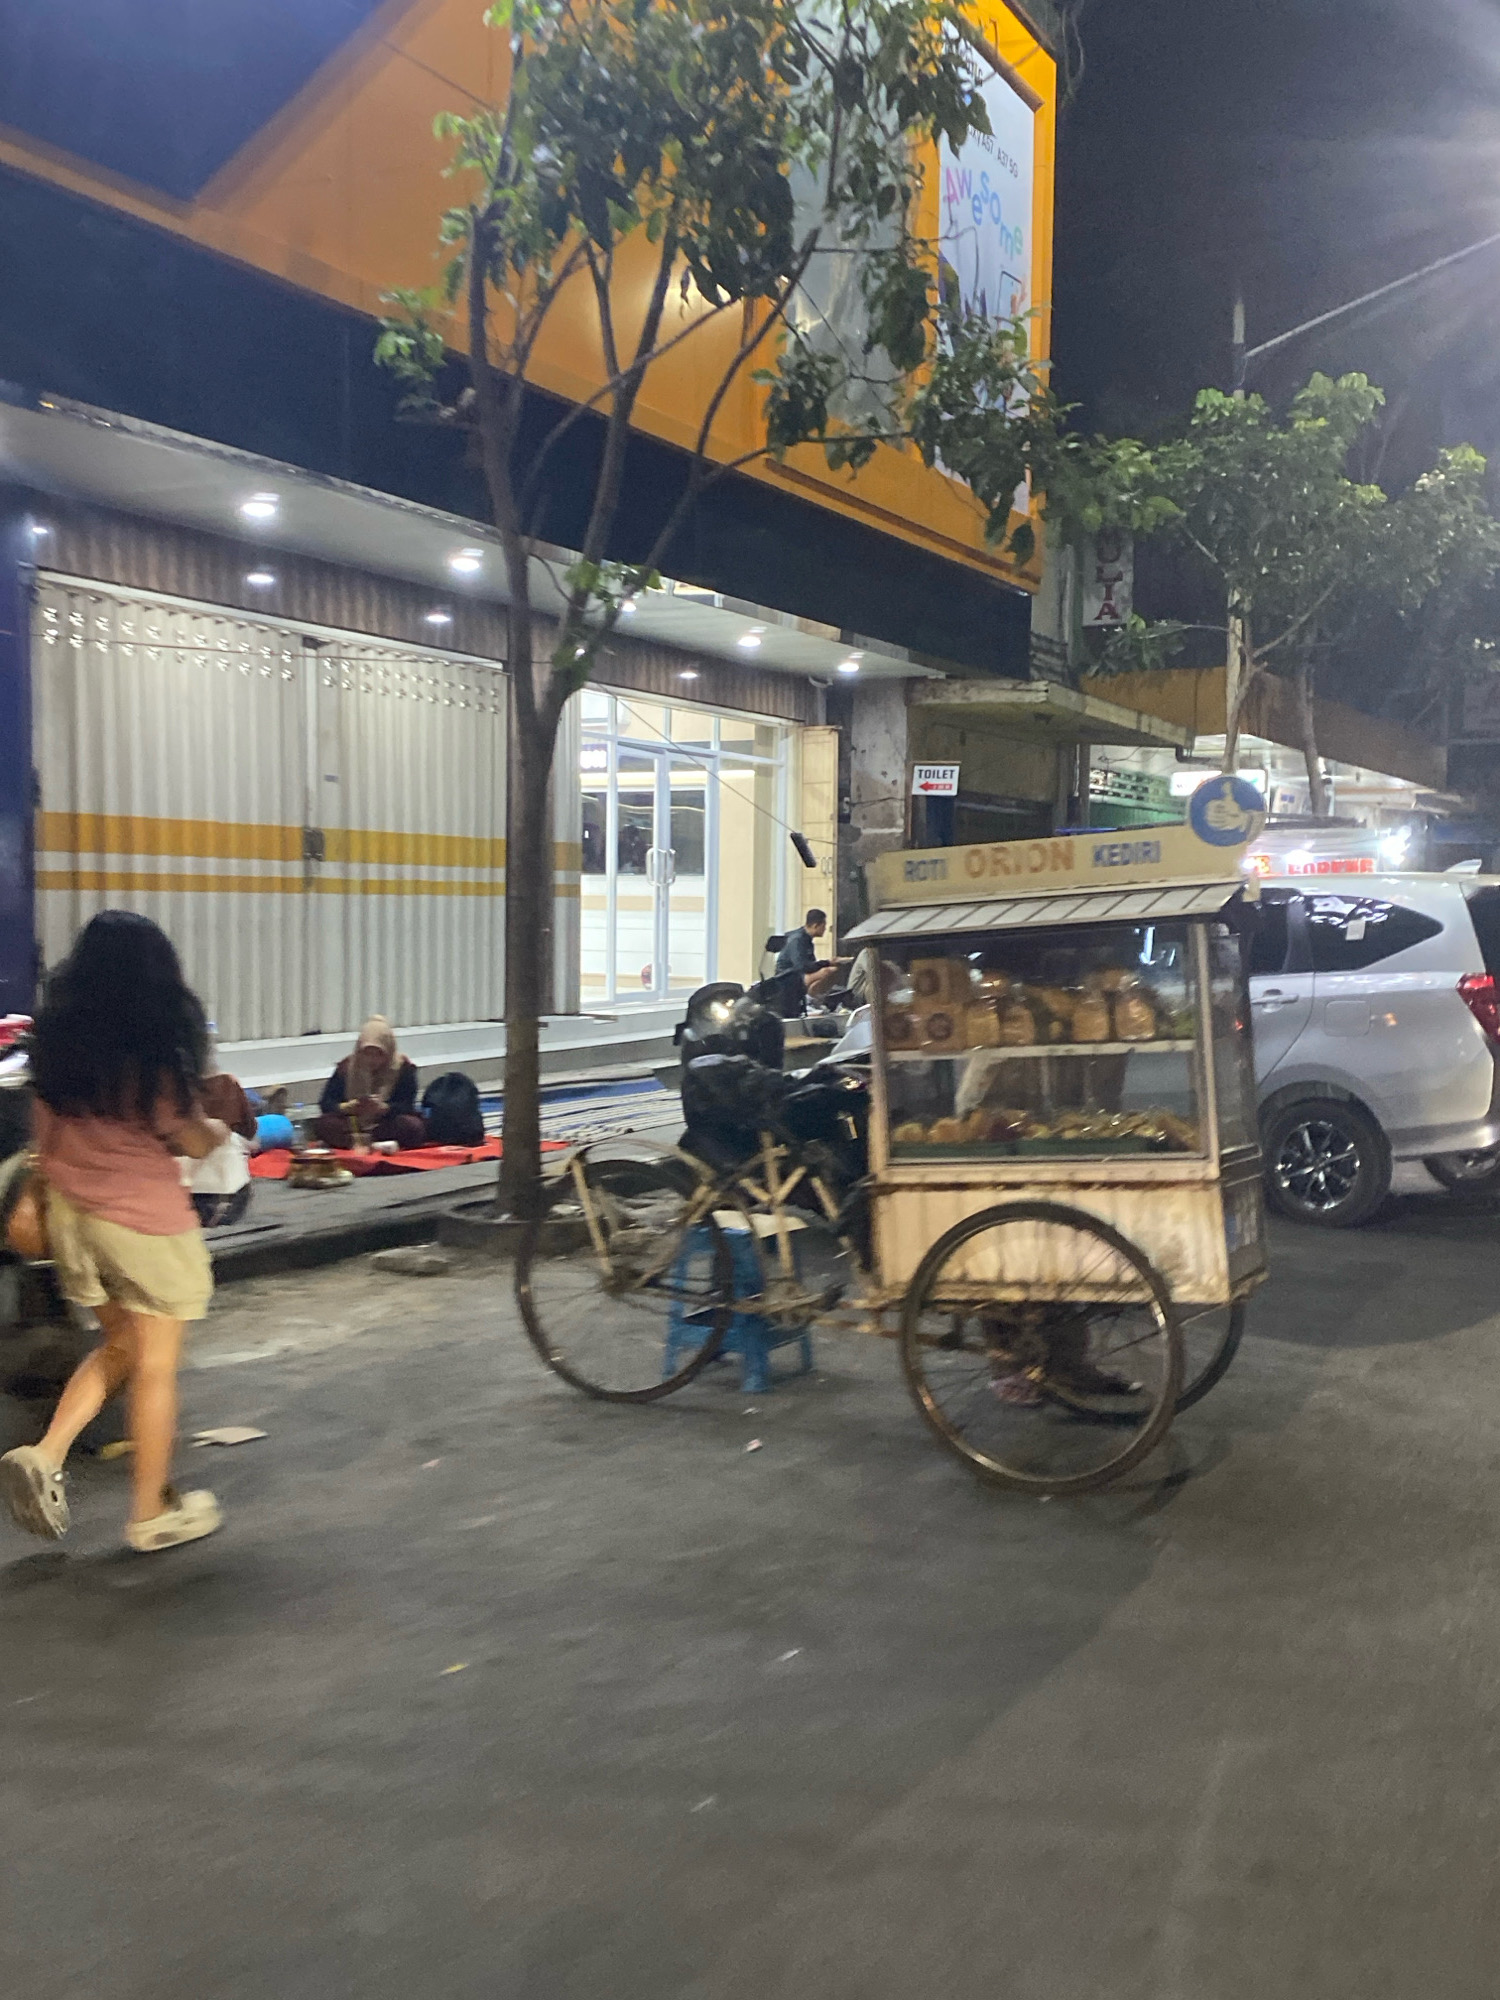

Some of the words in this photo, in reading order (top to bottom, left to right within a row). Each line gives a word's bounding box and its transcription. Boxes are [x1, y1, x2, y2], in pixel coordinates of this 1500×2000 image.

[918, 769, 955, 779] TOILET
[904, 858, 947, 882] ROTI
[964, 841, 1074, 879] ORION
[1092, 841, 1161, 868] KEDIRI
